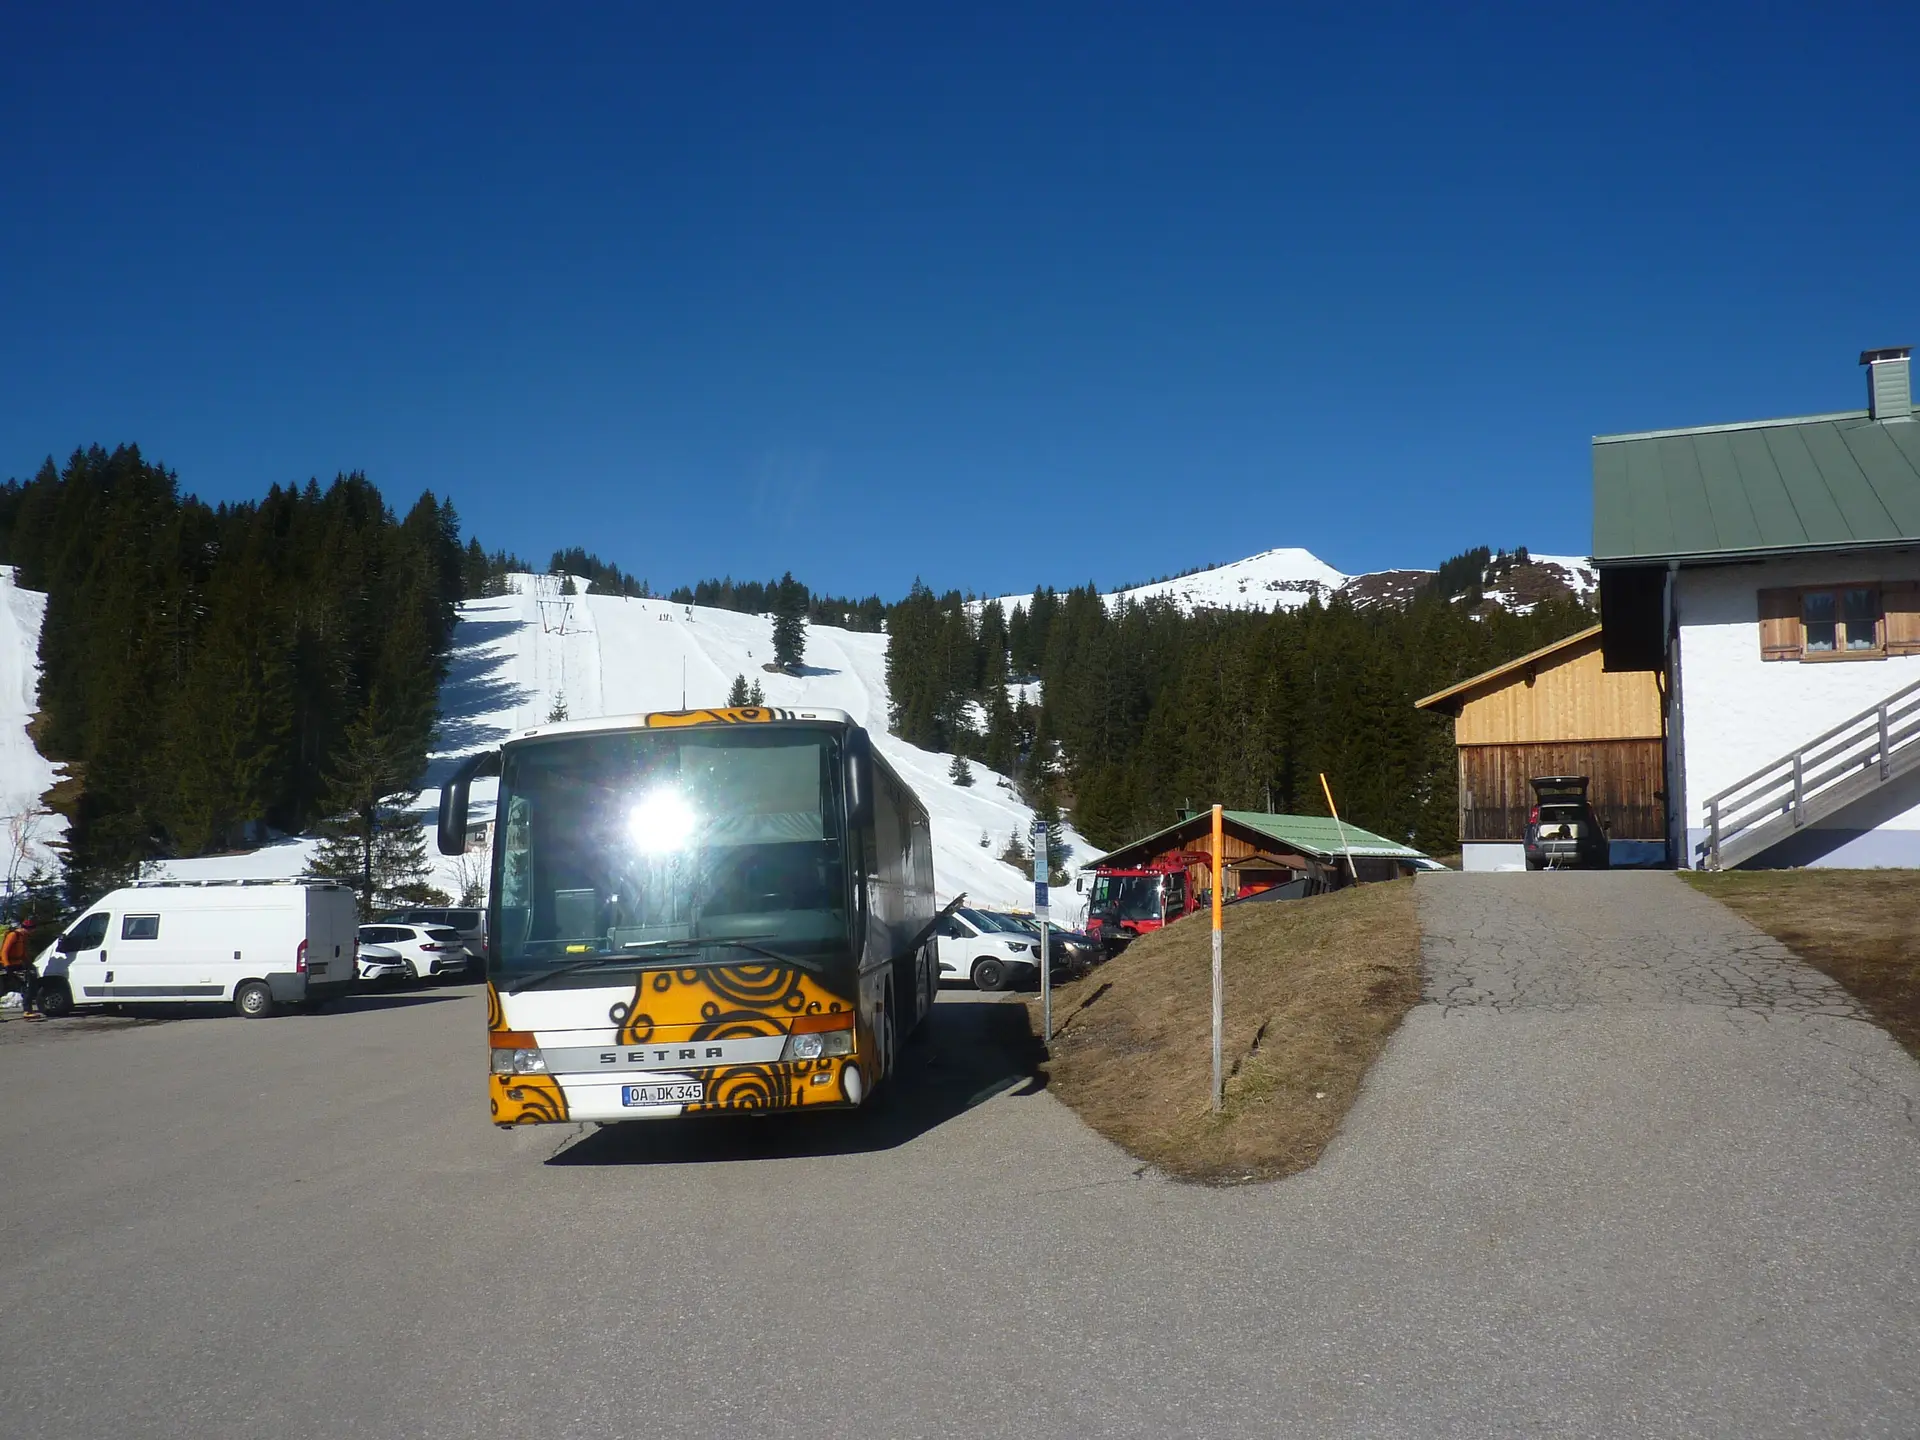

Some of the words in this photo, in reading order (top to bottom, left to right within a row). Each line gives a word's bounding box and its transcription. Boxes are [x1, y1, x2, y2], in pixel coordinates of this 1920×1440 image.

[600, 1047, 723, 1064] SETRA
[631, 1088, 648, 1101] OA
[657, 1087, 674, 1100] DK
[676, 1085, 701, 1099] 345
